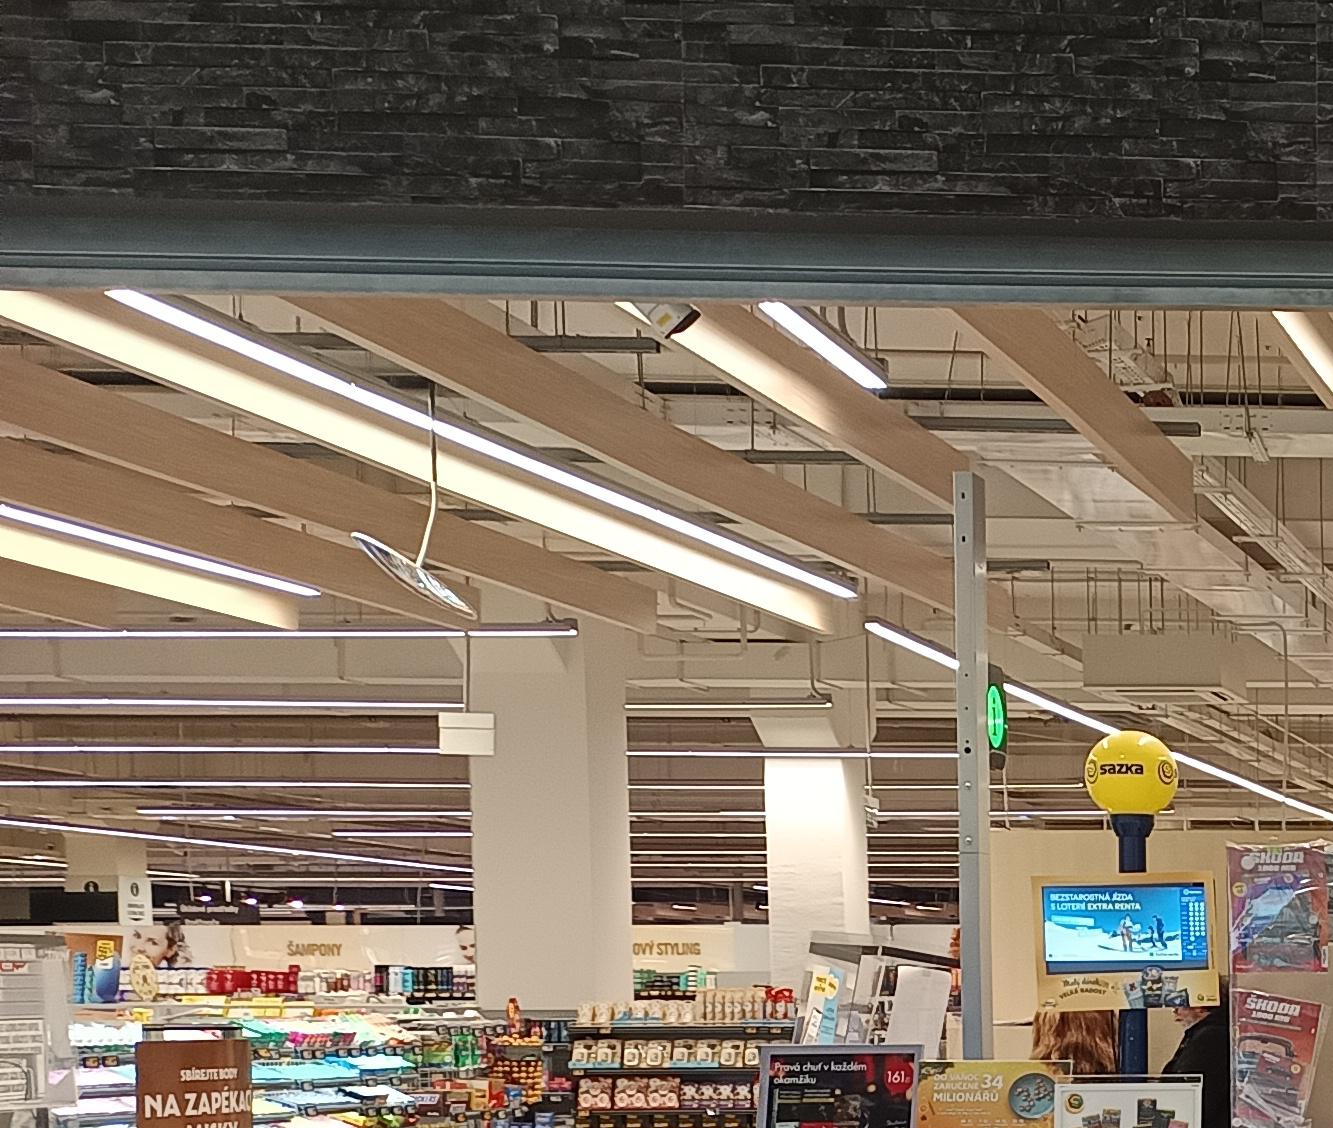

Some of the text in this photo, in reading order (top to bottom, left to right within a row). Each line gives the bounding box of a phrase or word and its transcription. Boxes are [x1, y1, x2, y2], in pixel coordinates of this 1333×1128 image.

[1099, 763, 1144, 775] sazka
[656, 941, 702, 957] STYLING
[774, 1061, 801, 1072] Pravá
[831, 1061, 867, 1071] každém
[774, 1074, 817, 1085] okamžiku
[887, 1070, 905, 1083] 161
[981, 1074, 1003, 1089] 34
[933, 1091, 999, 1103] MILIONÁŘŮ
[144, 1094, 181, 1119] NA
